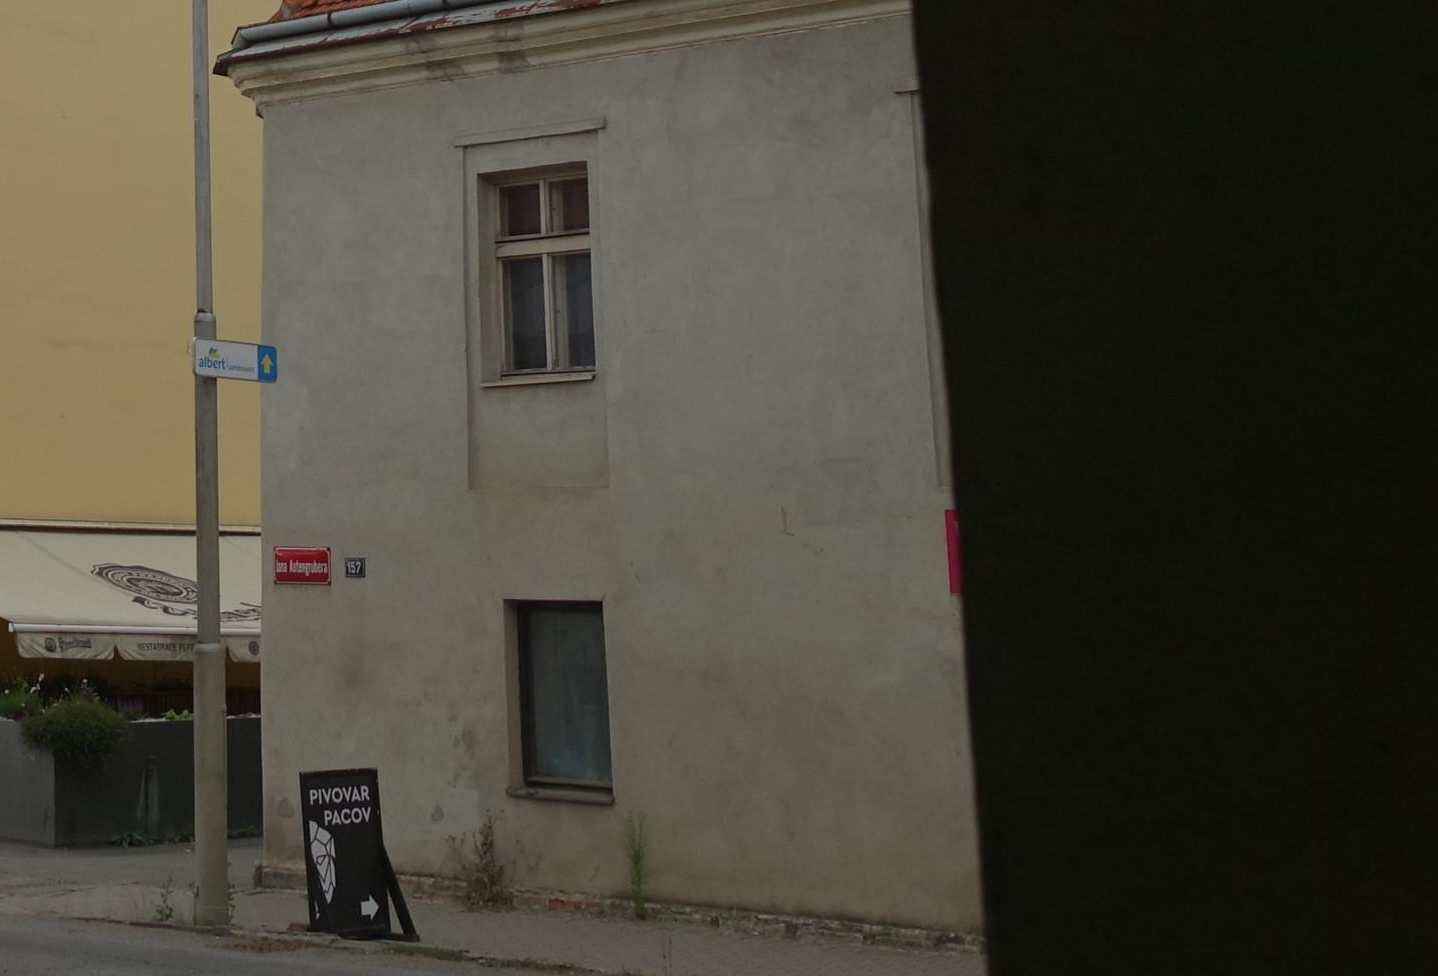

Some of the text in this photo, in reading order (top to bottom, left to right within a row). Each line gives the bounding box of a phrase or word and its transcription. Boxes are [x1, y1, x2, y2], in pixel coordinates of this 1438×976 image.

[198, 356, 226, 370] albert
[347, 561, 361, 574] 157
[178, 642, 195, 653] PEPP
[309, 785, 370, 805] PIVOVAR
[324, 807, 371, 826] PACOV
